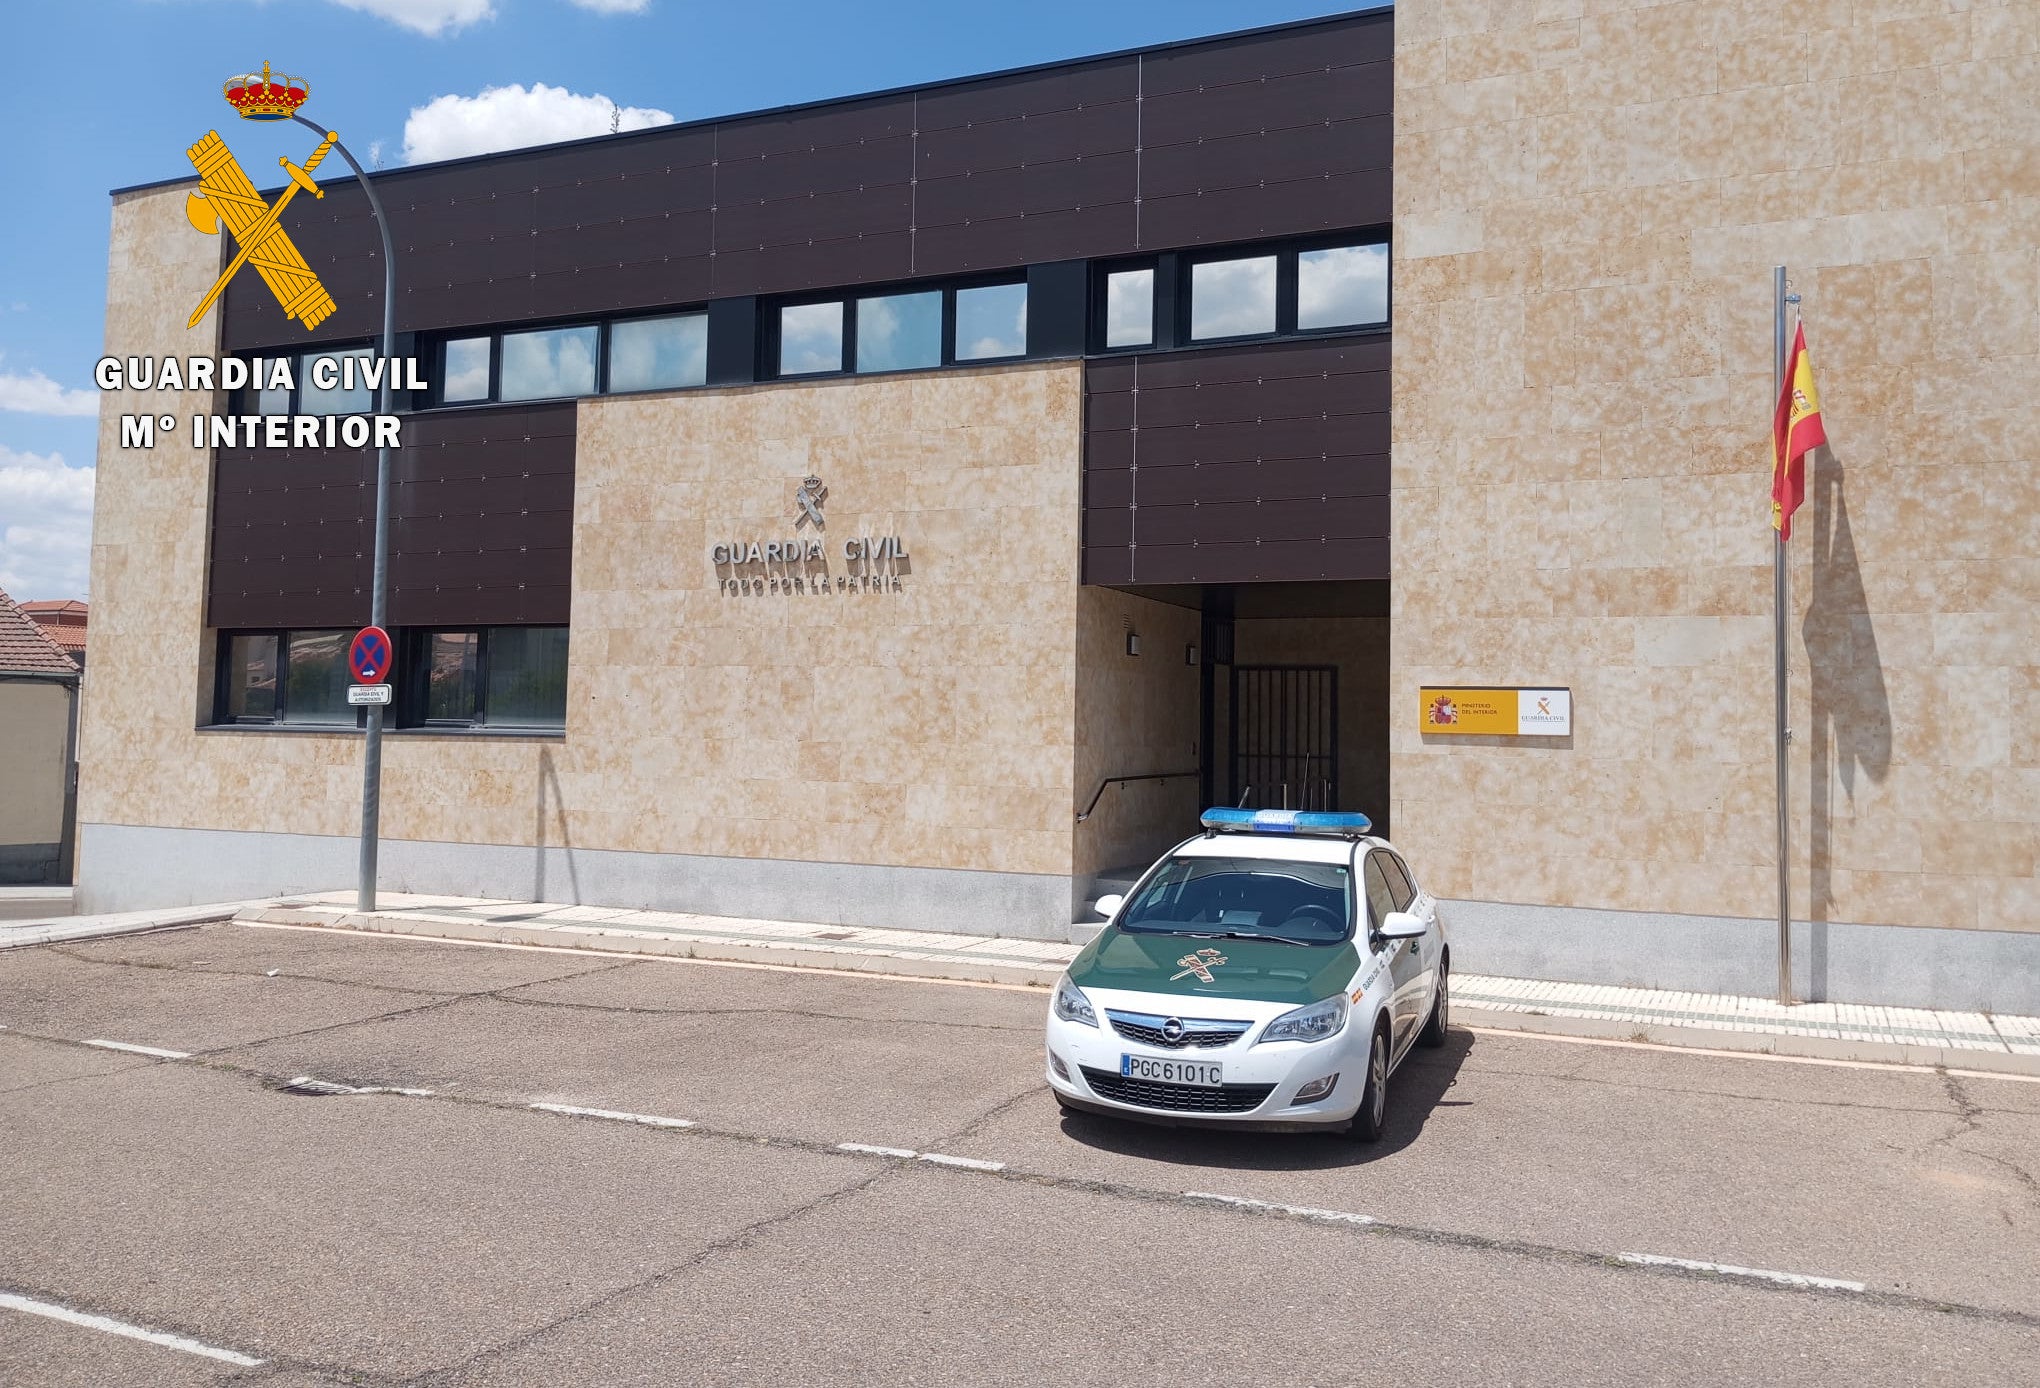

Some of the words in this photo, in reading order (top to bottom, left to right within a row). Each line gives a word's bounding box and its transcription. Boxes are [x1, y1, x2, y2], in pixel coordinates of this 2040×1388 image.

[712, 539, 825, 565] GUARDIA
[844, 536, 909, 560] CIVIL
[769, 577, 804, 593] POR
[836, 574, 902, 591] PATRIA
[1131, 1058, 1221, 1084] PGC6101C
